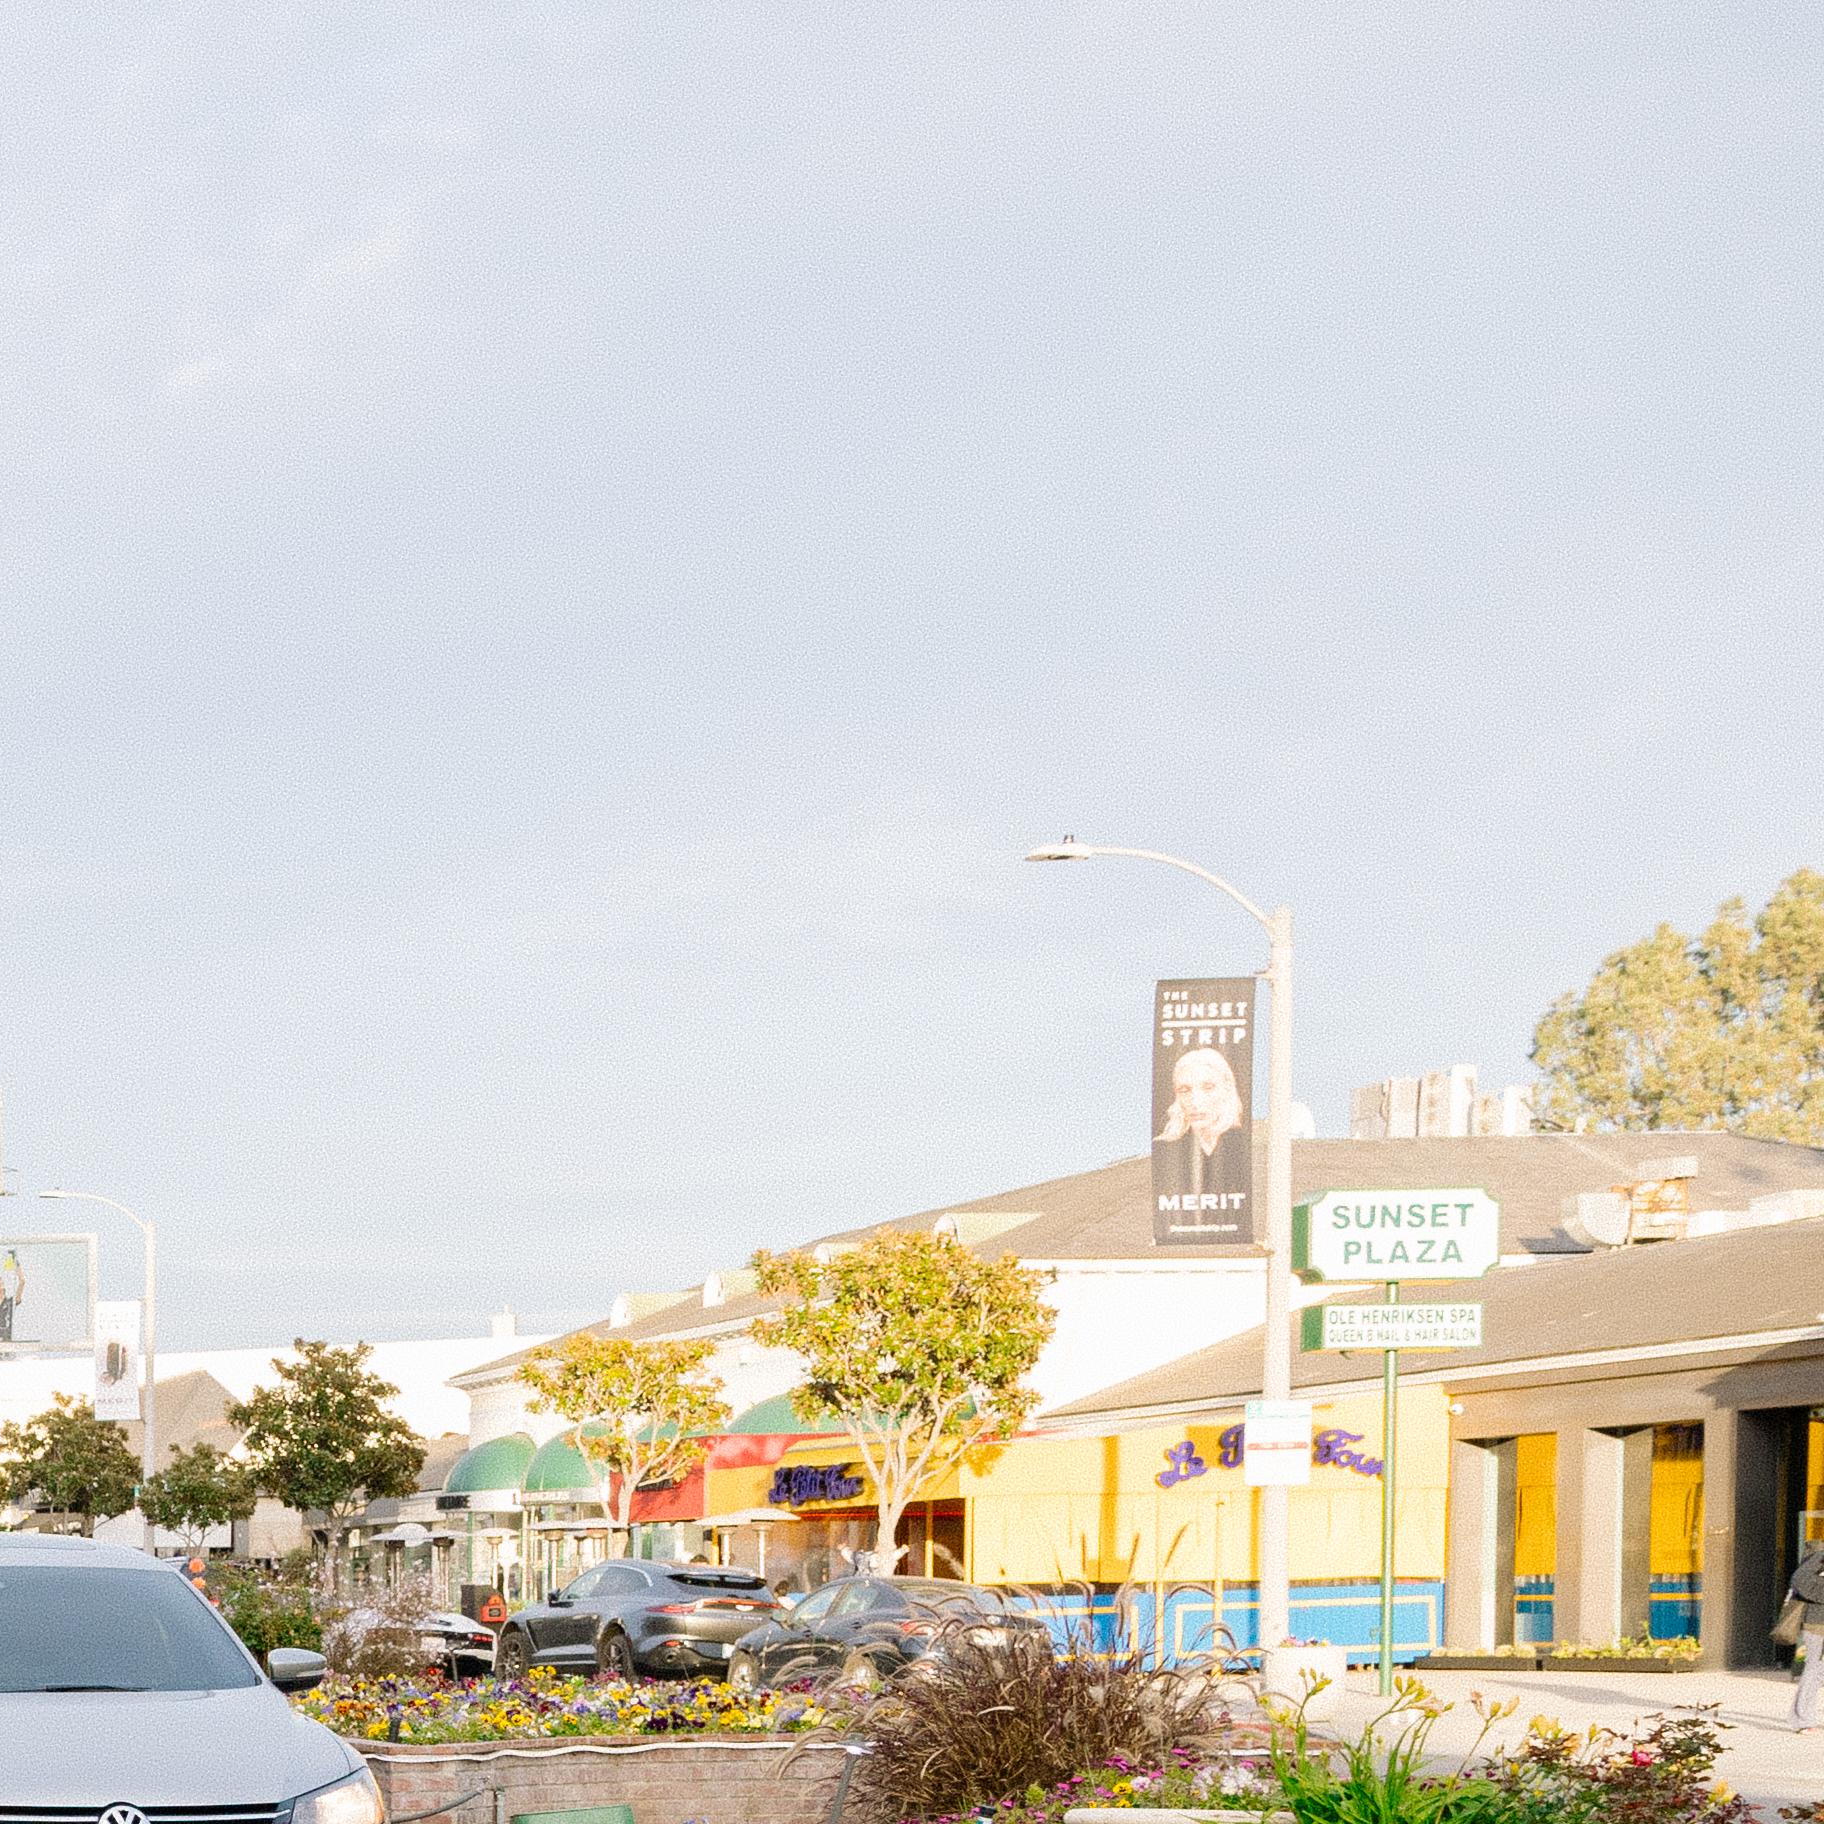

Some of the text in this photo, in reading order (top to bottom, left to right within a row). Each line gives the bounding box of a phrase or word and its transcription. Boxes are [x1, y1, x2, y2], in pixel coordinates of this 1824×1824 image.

[1163, 991, 1189, 1001] THE
[1162, 1001, 1248, 1019] SUNSET
[1162, 1027, 1247, 1046] STRIP
[1157, 1193, 1246, 1211] MERIT
[1331, 1203, 1474, 1229] SUNSET
[1343, 1240, 1463, 1265] PLAZA
[1328, 1308, 1475, 1325] OLE HENRIKSEN SPA
[1442, 1327, 1477, 1340] SALON
[1155, 1440, 1207, 1488] Le
